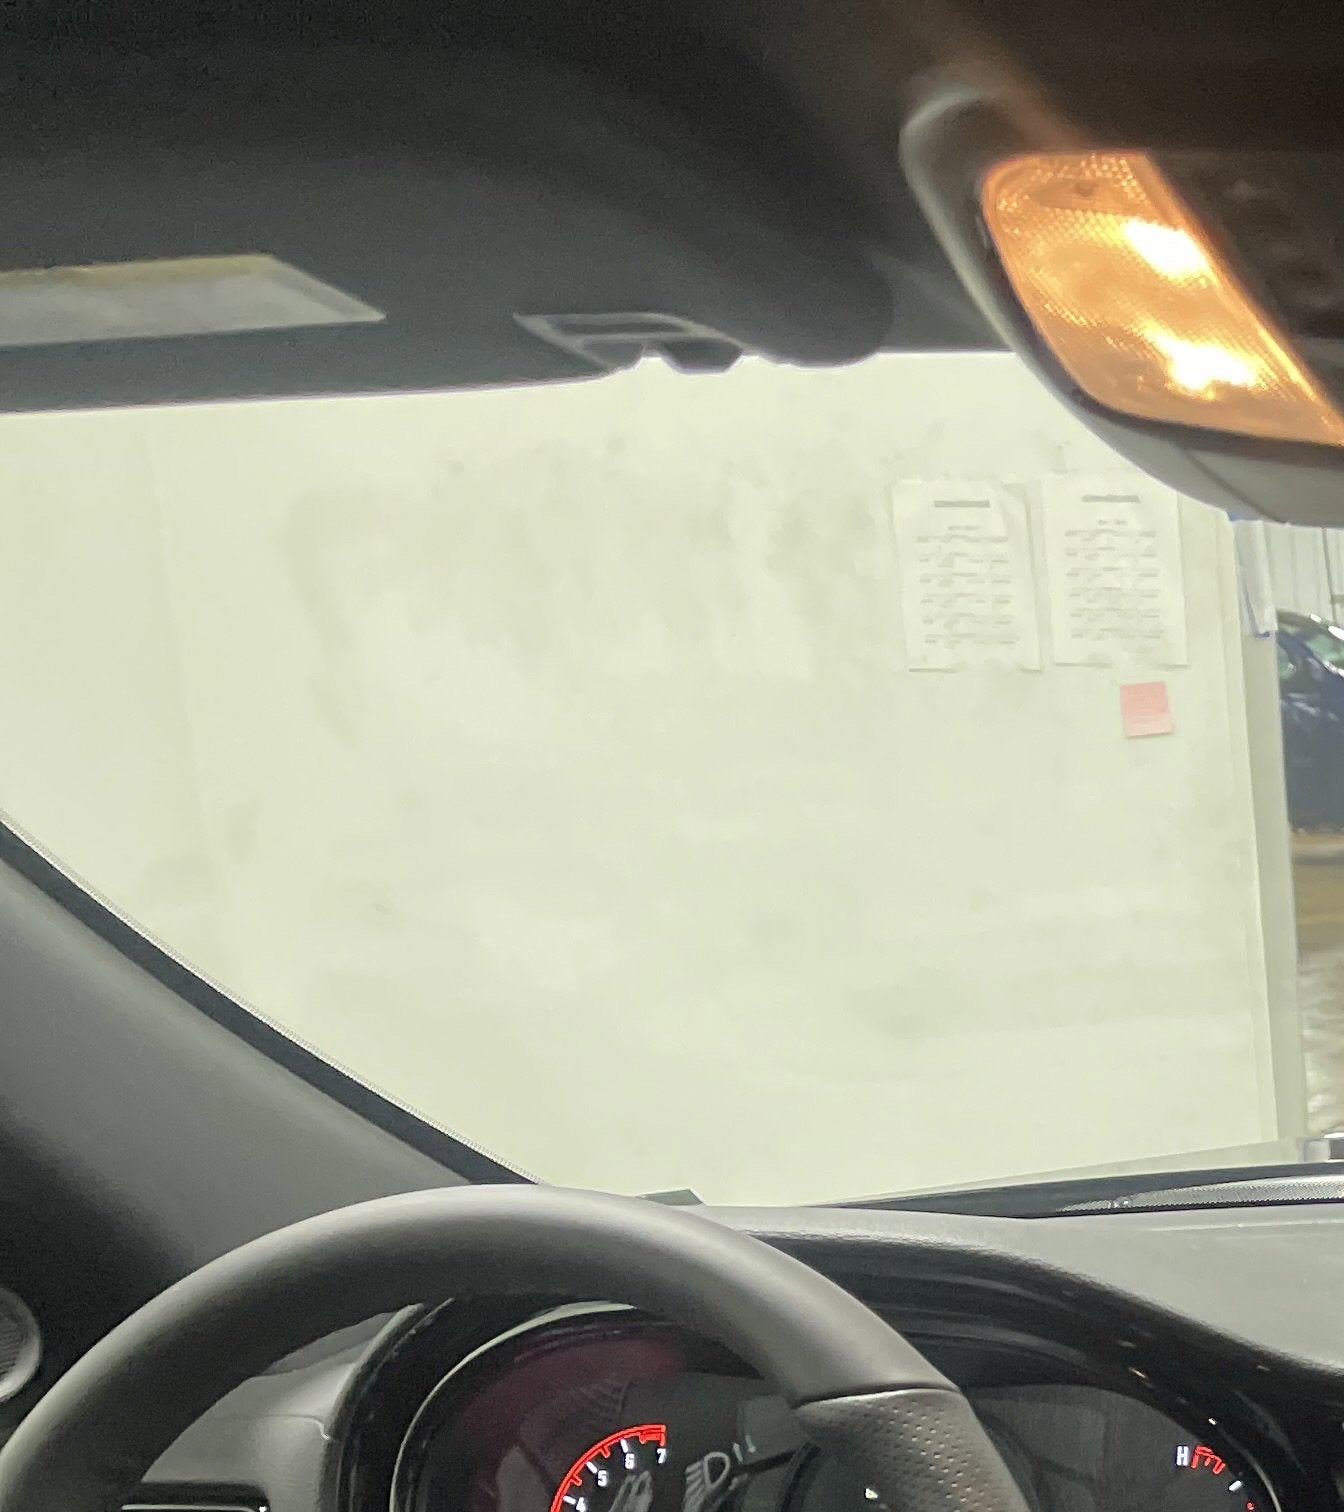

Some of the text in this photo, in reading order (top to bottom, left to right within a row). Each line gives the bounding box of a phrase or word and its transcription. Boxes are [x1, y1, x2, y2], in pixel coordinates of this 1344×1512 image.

[623, 1452, 636, 1471] 6
[656, 1447, 668, 1465] 7
[1176, 1445, 1189, 1466] H
[596, 1469, 609, 1488] 5
